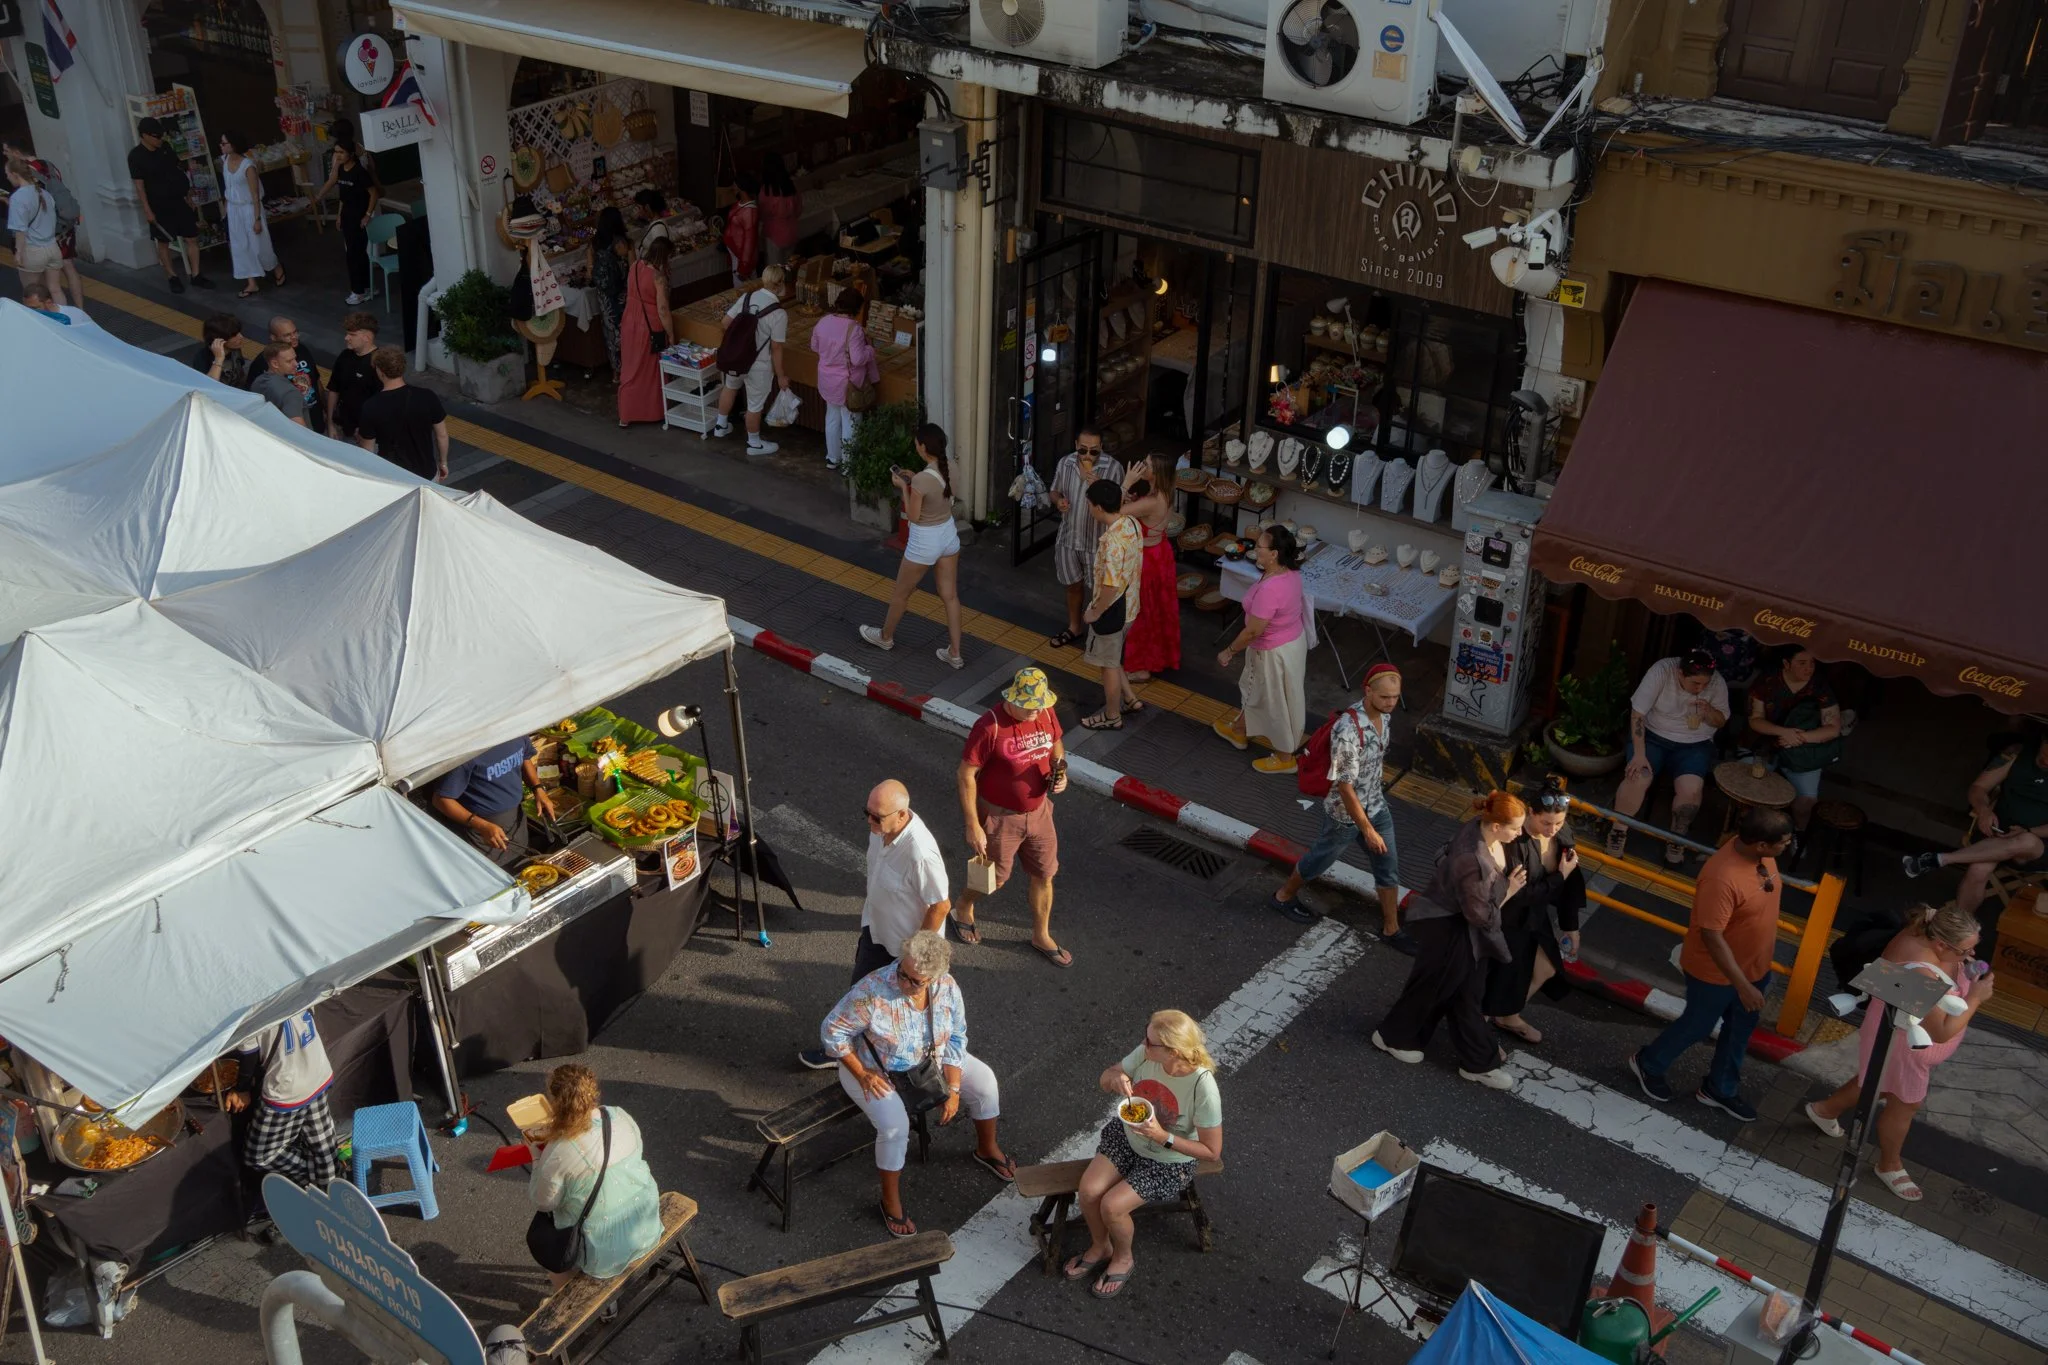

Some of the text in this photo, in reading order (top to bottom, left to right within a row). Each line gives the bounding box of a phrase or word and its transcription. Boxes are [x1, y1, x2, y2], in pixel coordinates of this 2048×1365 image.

[1361, 162, 1457, 222] CHINO
[1360, 257, 1444, 289] Since 2009
[1569, 555, 1627, 585] Coca-Cola
[1753, 608, 1818, 639] Coca-Cola
[1958, 665, 2031, 699] Coca-Cola
[316, 1219, 422, 1312] ถนนถลาง
[328, 1251, 422, 1330] THALANG ROAD
